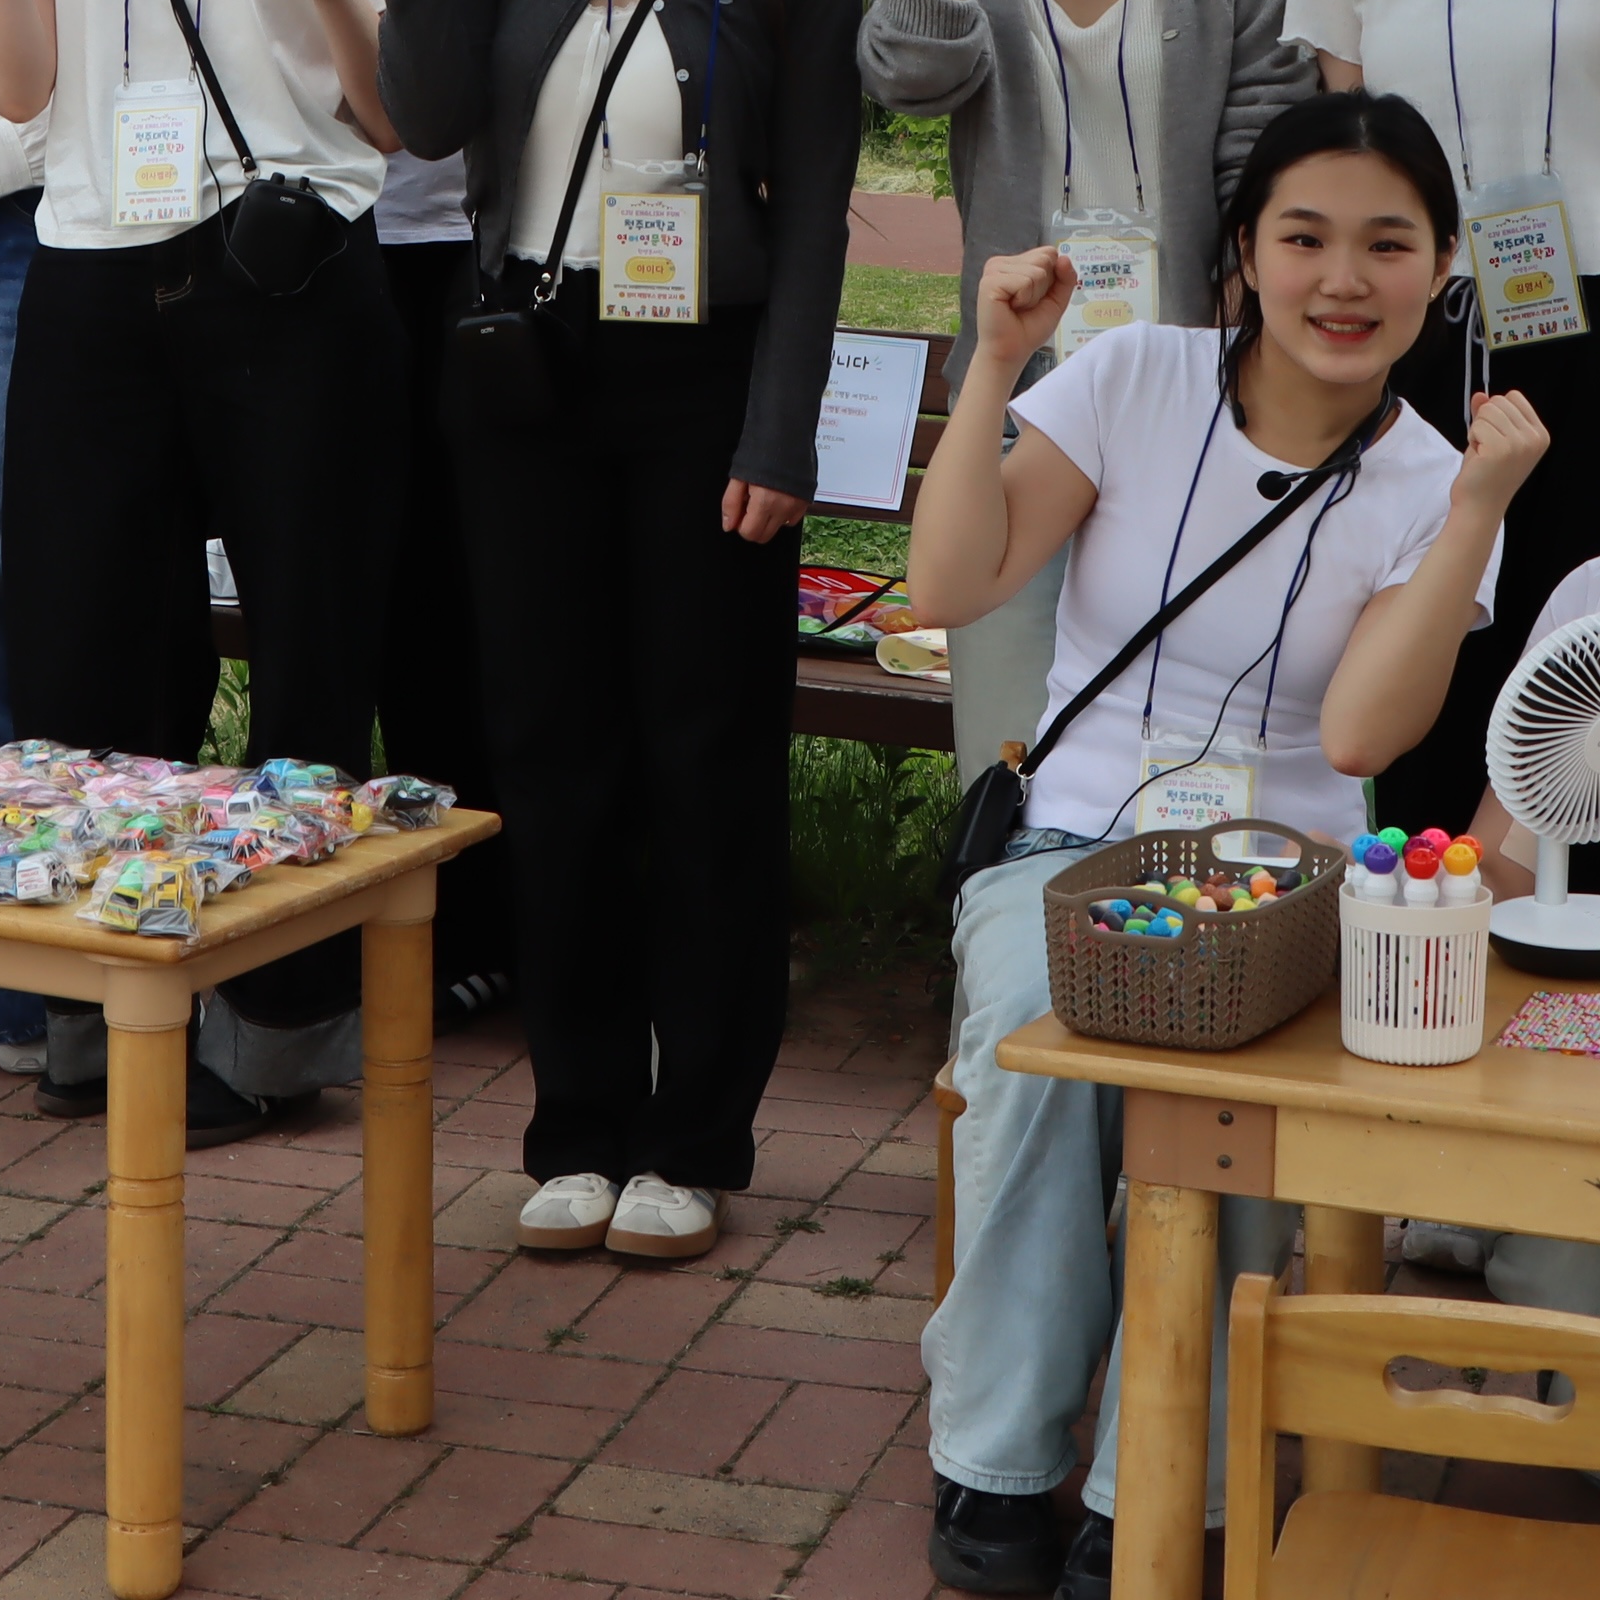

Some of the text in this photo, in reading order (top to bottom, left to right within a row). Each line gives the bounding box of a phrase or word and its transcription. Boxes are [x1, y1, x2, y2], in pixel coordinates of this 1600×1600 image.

[624, 218, 675, 232] 청주대학교
[617, 233, 683, 247] 영어영문학과
[1493, 233, 1545, 251] 청주대학교
[1489, 247, 1555, 268] 영어영문학과
[637, 264, 664, 275] 아이다
[832, 350, 869, 371] 니다
[1166, 789, 1224, 806] 청주대학교
[1157, 806, 1232, 822] 영어영문학과
